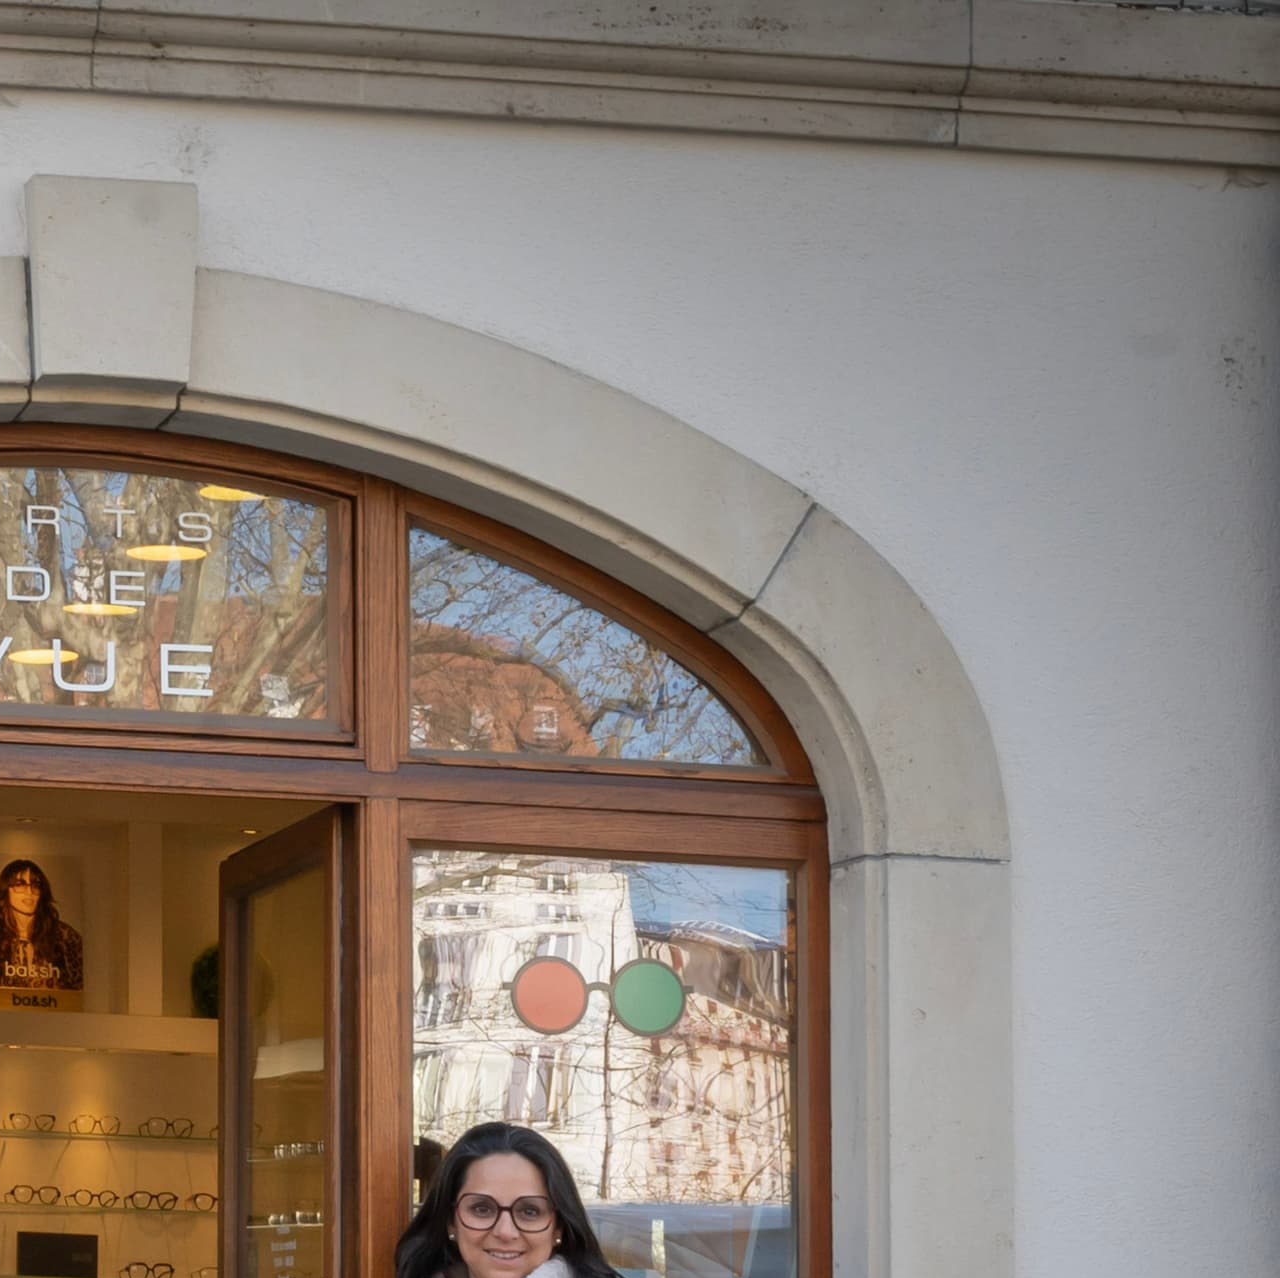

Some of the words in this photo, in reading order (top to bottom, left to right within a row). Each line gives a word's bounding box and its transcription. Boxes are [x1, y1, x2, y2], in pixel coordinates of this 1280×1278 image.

[5, 566, 146, 606] DE
[4, 961, 60, 979] ba&sh
[12, 993, 58, 1008] ba&sh
